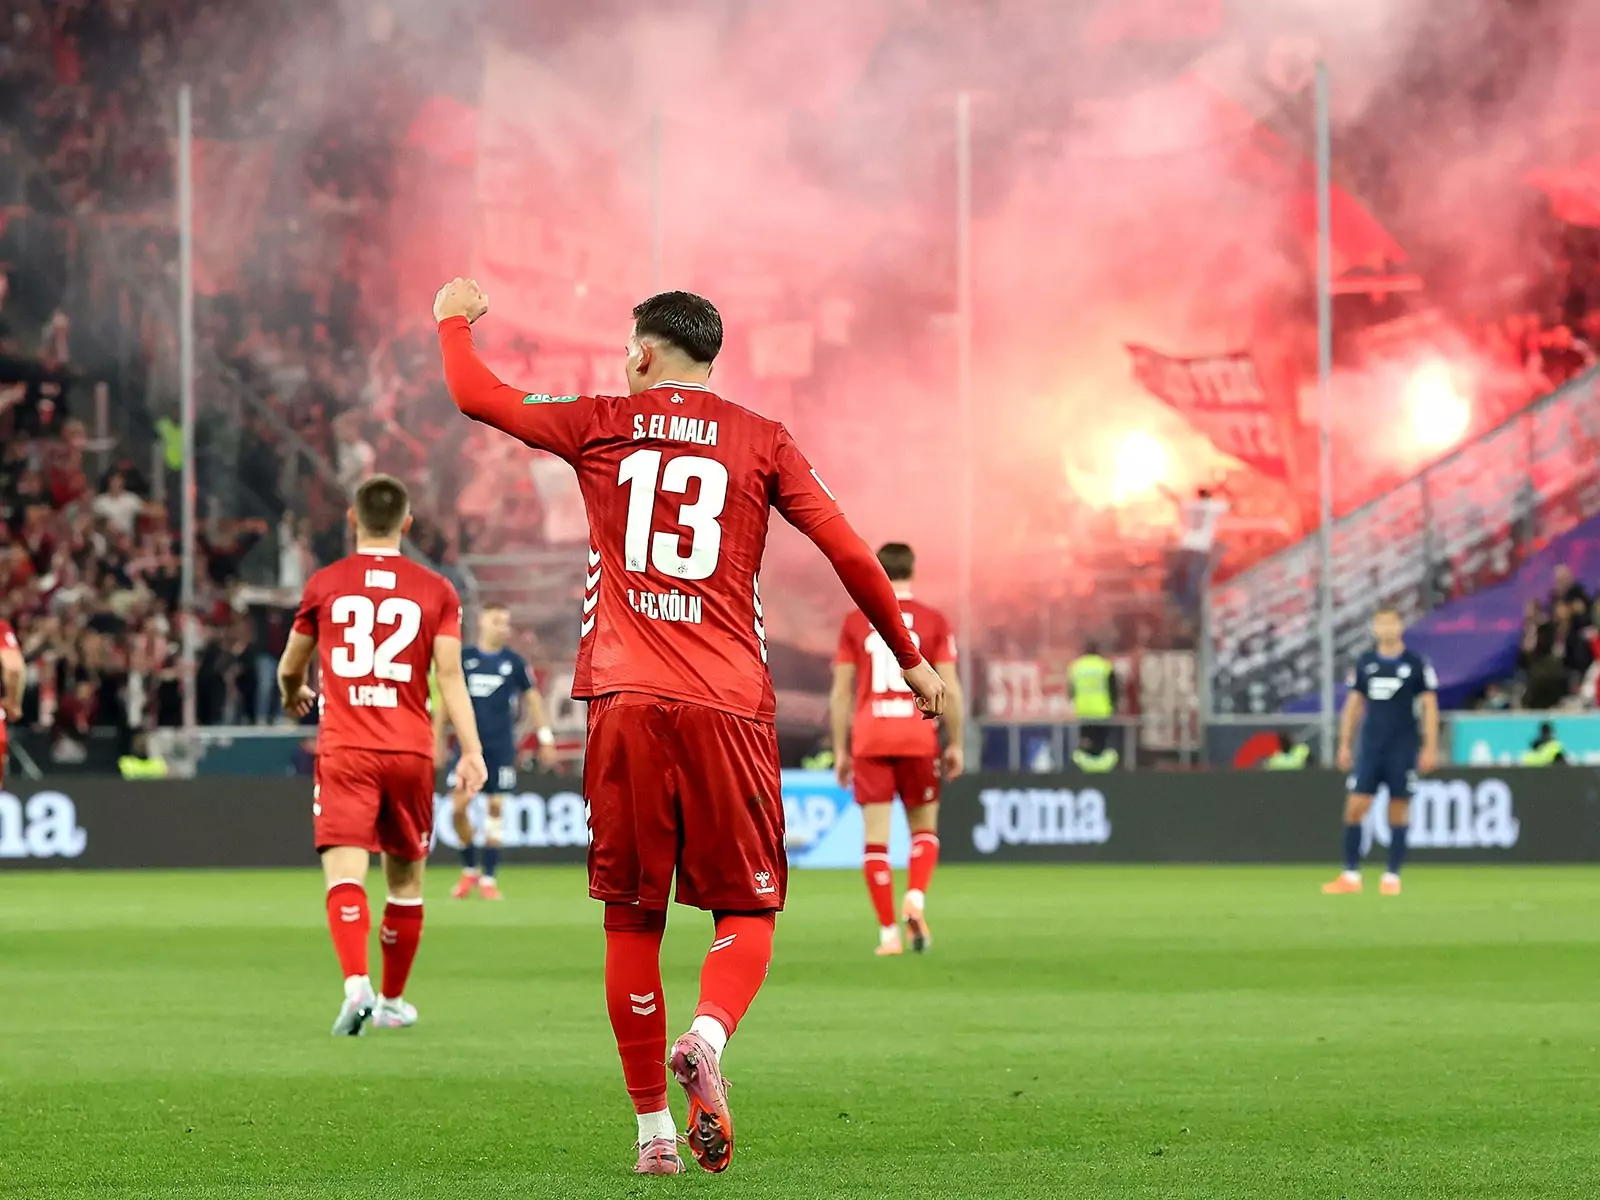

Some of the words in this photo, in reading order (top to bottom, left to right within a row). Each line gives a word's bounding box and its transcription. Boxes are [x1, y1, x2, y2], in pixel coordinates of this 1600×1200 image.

[632, 414, 646, 440] S.
[648, 414, 667, 439] EL
[668, 415, 719, 446] MALA
[617, 448, 729, 581] 13
[658, 588, 703, 625] KÖLN
[331, 595, 422, 683] 32
[785, 795, 838, 841] AP
